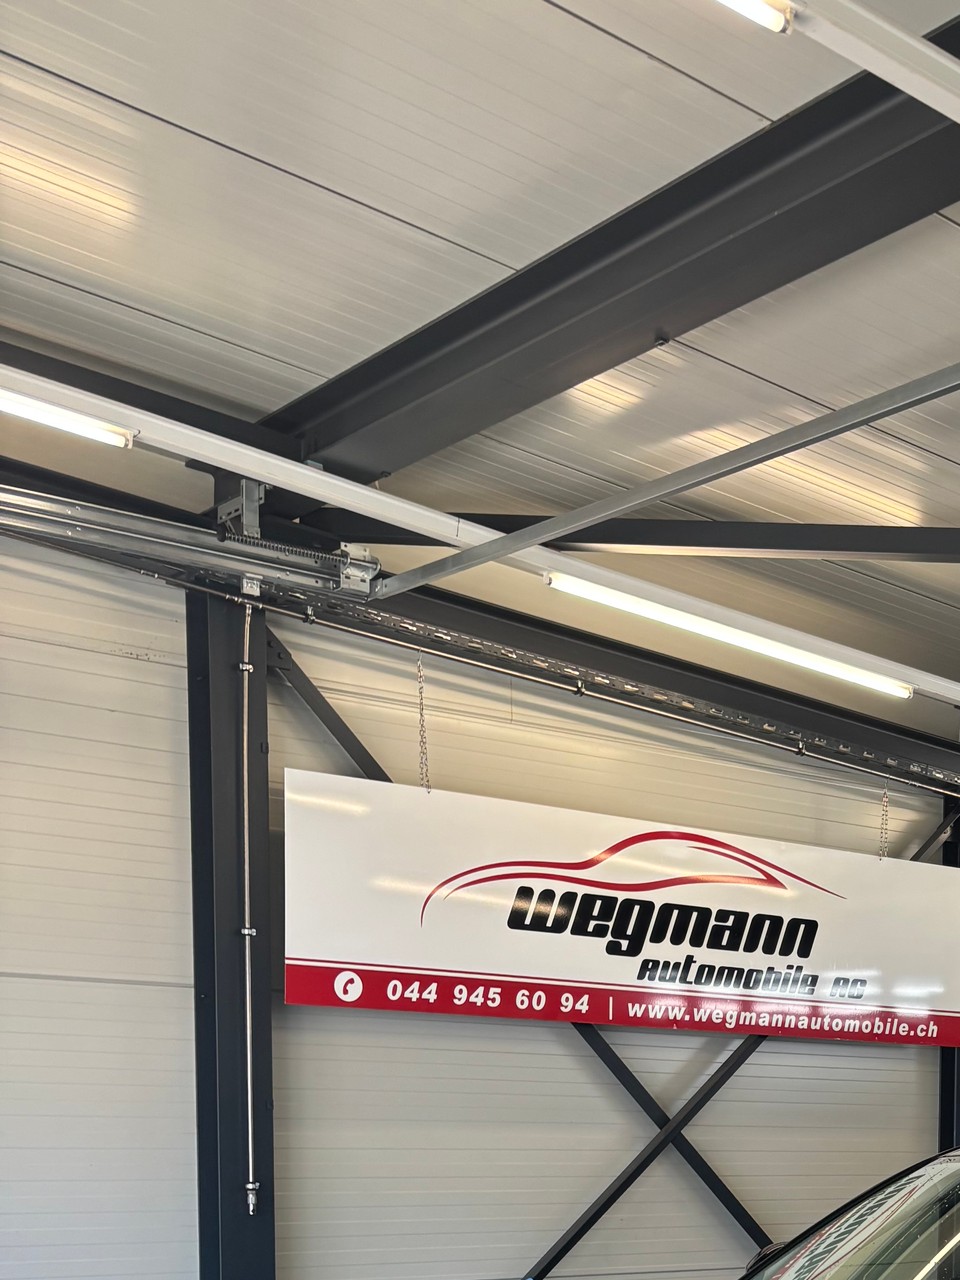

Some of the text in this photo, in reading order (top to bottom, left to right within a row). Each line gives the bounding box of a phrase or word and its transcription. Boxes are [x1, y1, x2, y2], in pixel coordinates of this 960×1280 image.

[507, 885, 819, 958] wegmann
[386, 979, 938, 1038] 044 945 60 94 www.wegmannautomobile.ch
[829, 975, 868, 1000] AG
